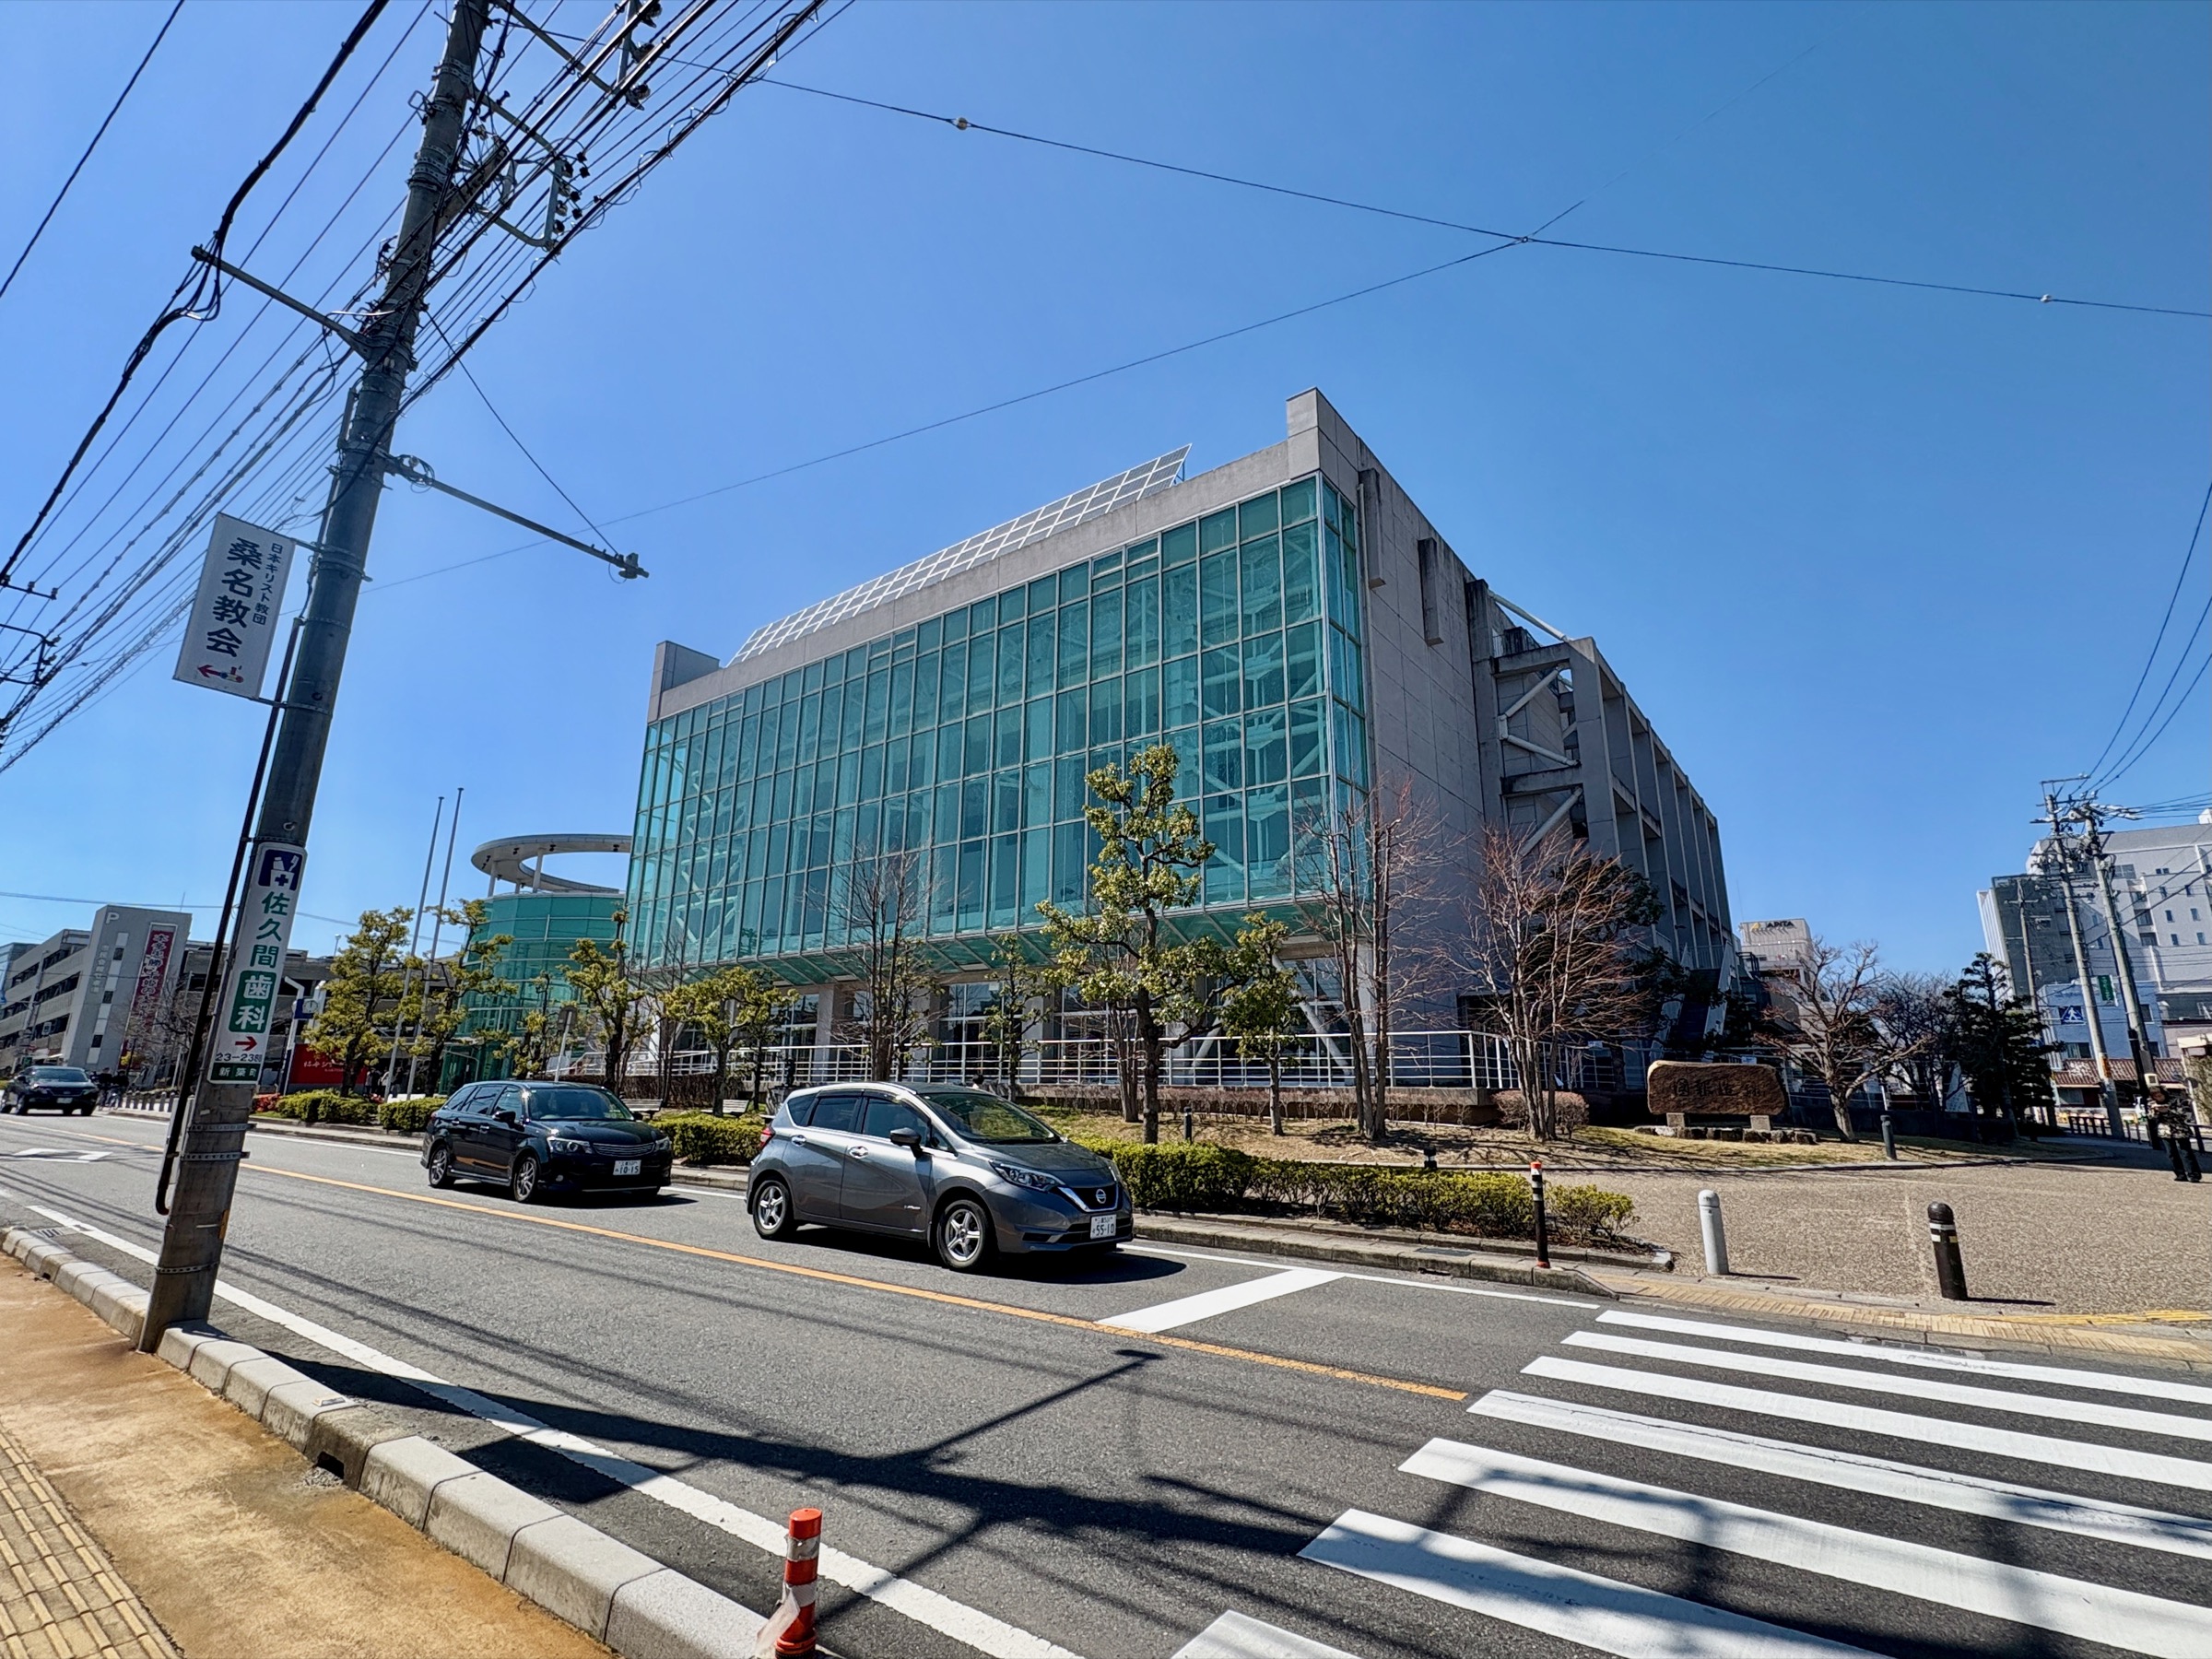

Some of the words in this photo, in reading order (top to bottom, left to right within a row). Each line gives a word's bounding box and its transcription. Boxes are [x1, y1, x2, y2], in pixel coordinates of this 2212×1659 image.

[206, 536, 263, 658] 桑名教会
[253, 543, 283, 626] 日本キリスト教団
[105, 912, 120, 924] P
[235, 891, 291, 1030] 佐久間歯科
